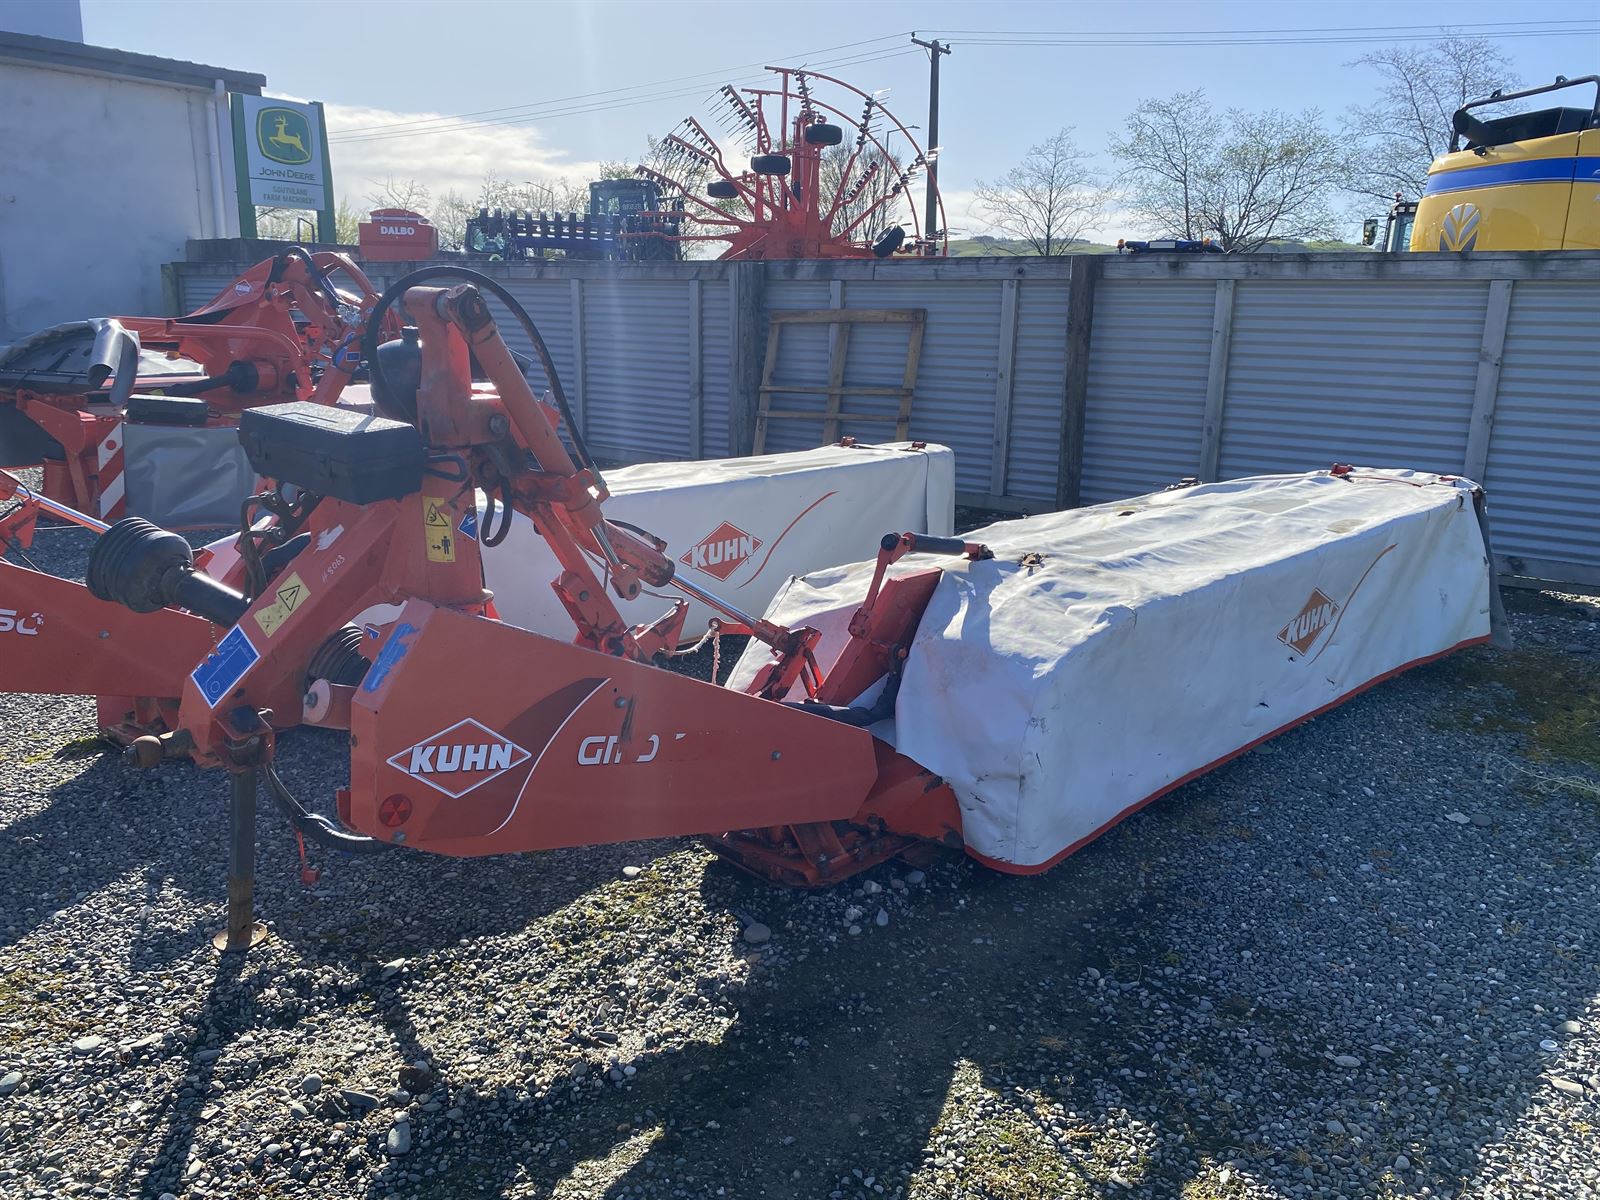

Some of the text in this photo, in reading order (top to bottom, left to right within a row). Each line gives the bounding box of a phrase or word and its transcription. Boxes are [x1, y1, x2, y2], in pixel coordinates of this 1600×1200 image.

[259, 167, 316, 181] JOHN DEERE
[263, 193, 281, 201] FARM
[380, 225, 415, 236] DALBO
[691, 536, 753, 569] KUHN
[1286, 601, 1334, 645] KUHN
[409, 743, 513, 773] KUHN
